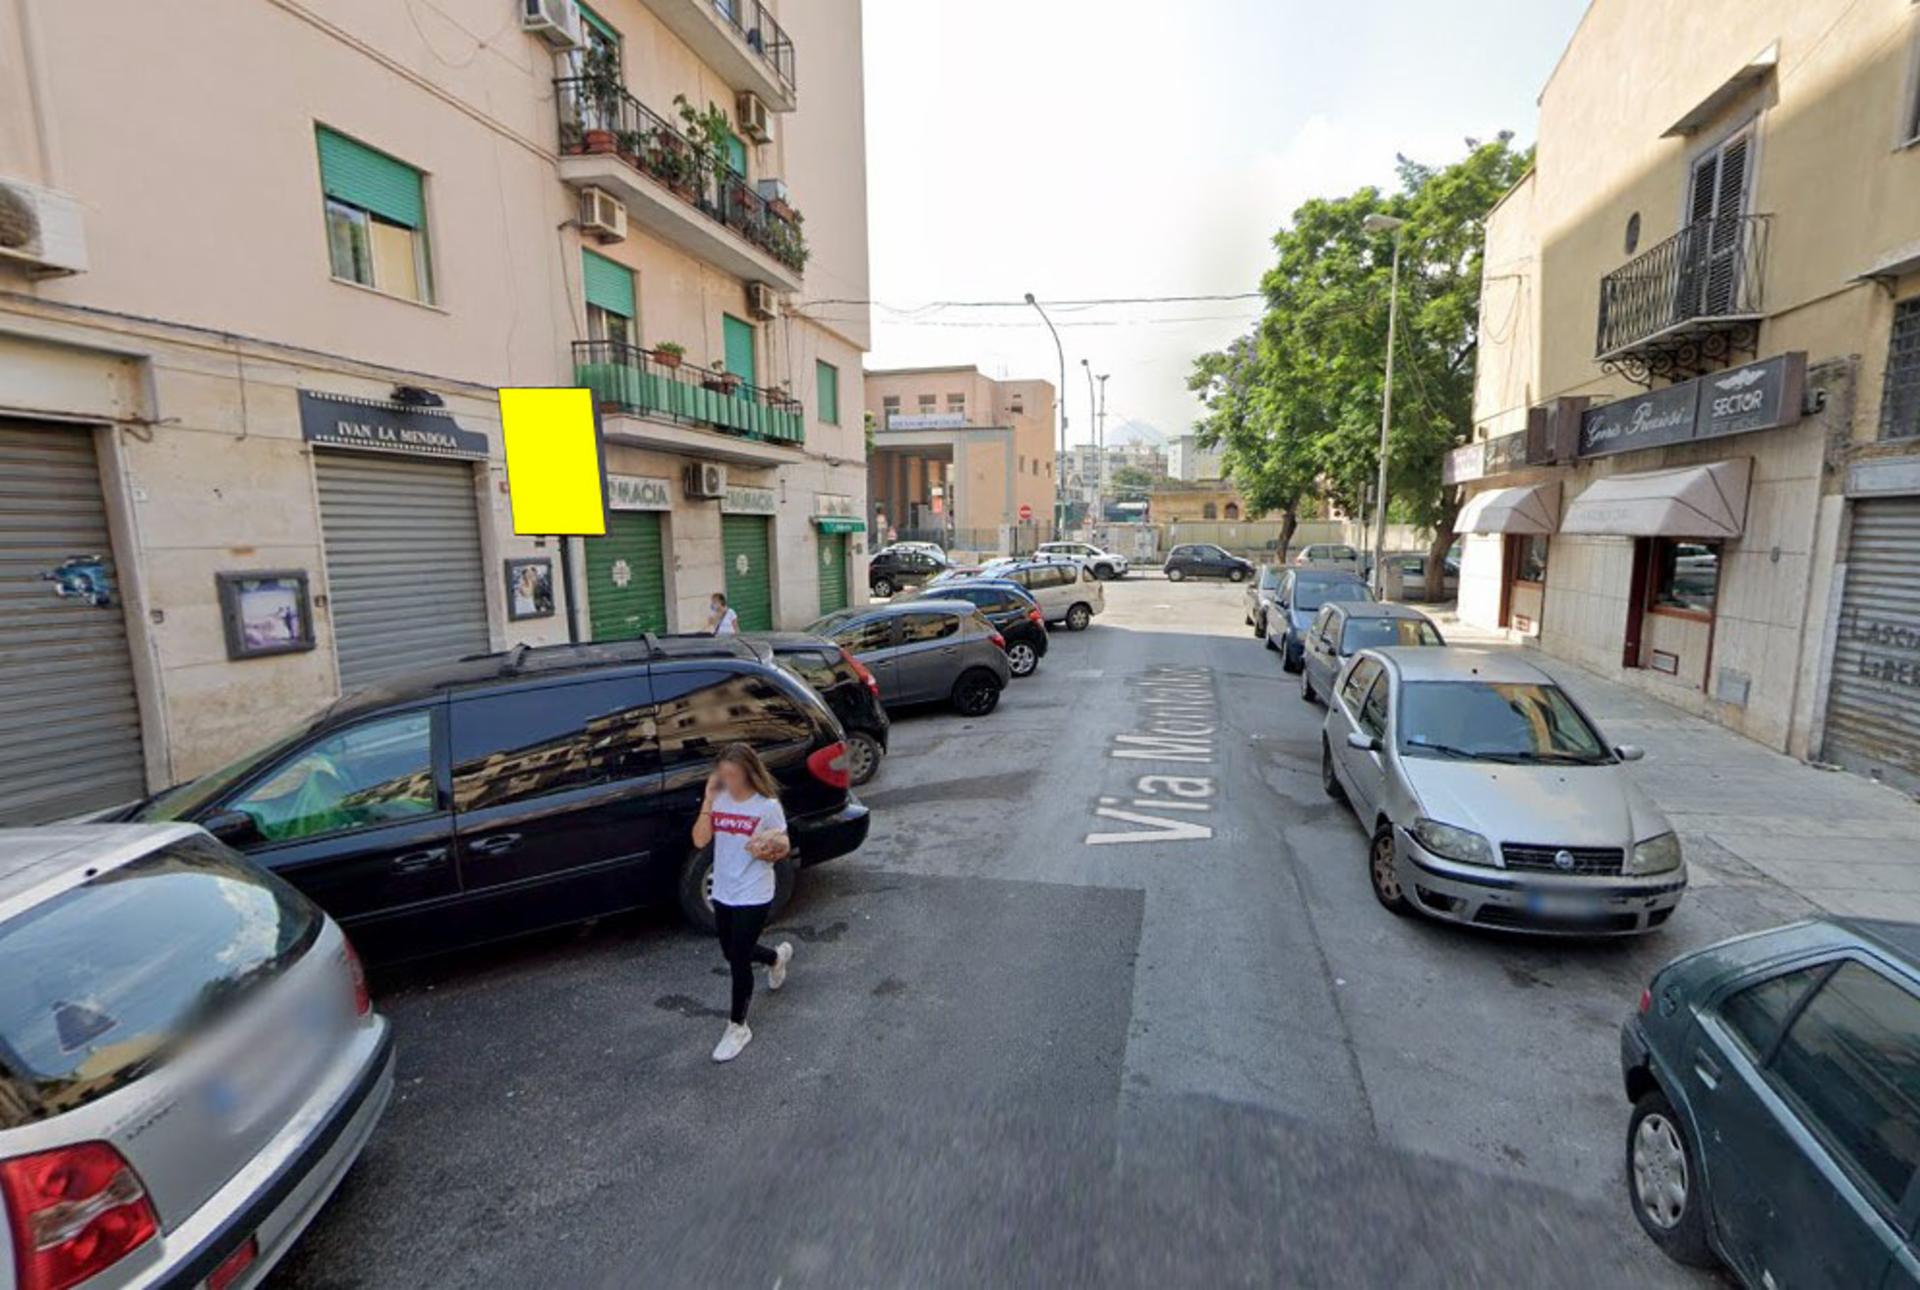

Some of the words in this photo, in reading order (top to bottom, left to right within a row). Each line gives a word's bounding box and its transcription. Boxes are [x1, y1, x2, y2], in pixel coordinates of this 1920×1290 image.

[1712, 390, 1763, 418] SECTOR
[337, 421, 372, 438] IVAN
[378, 426, 396, 441] LA
